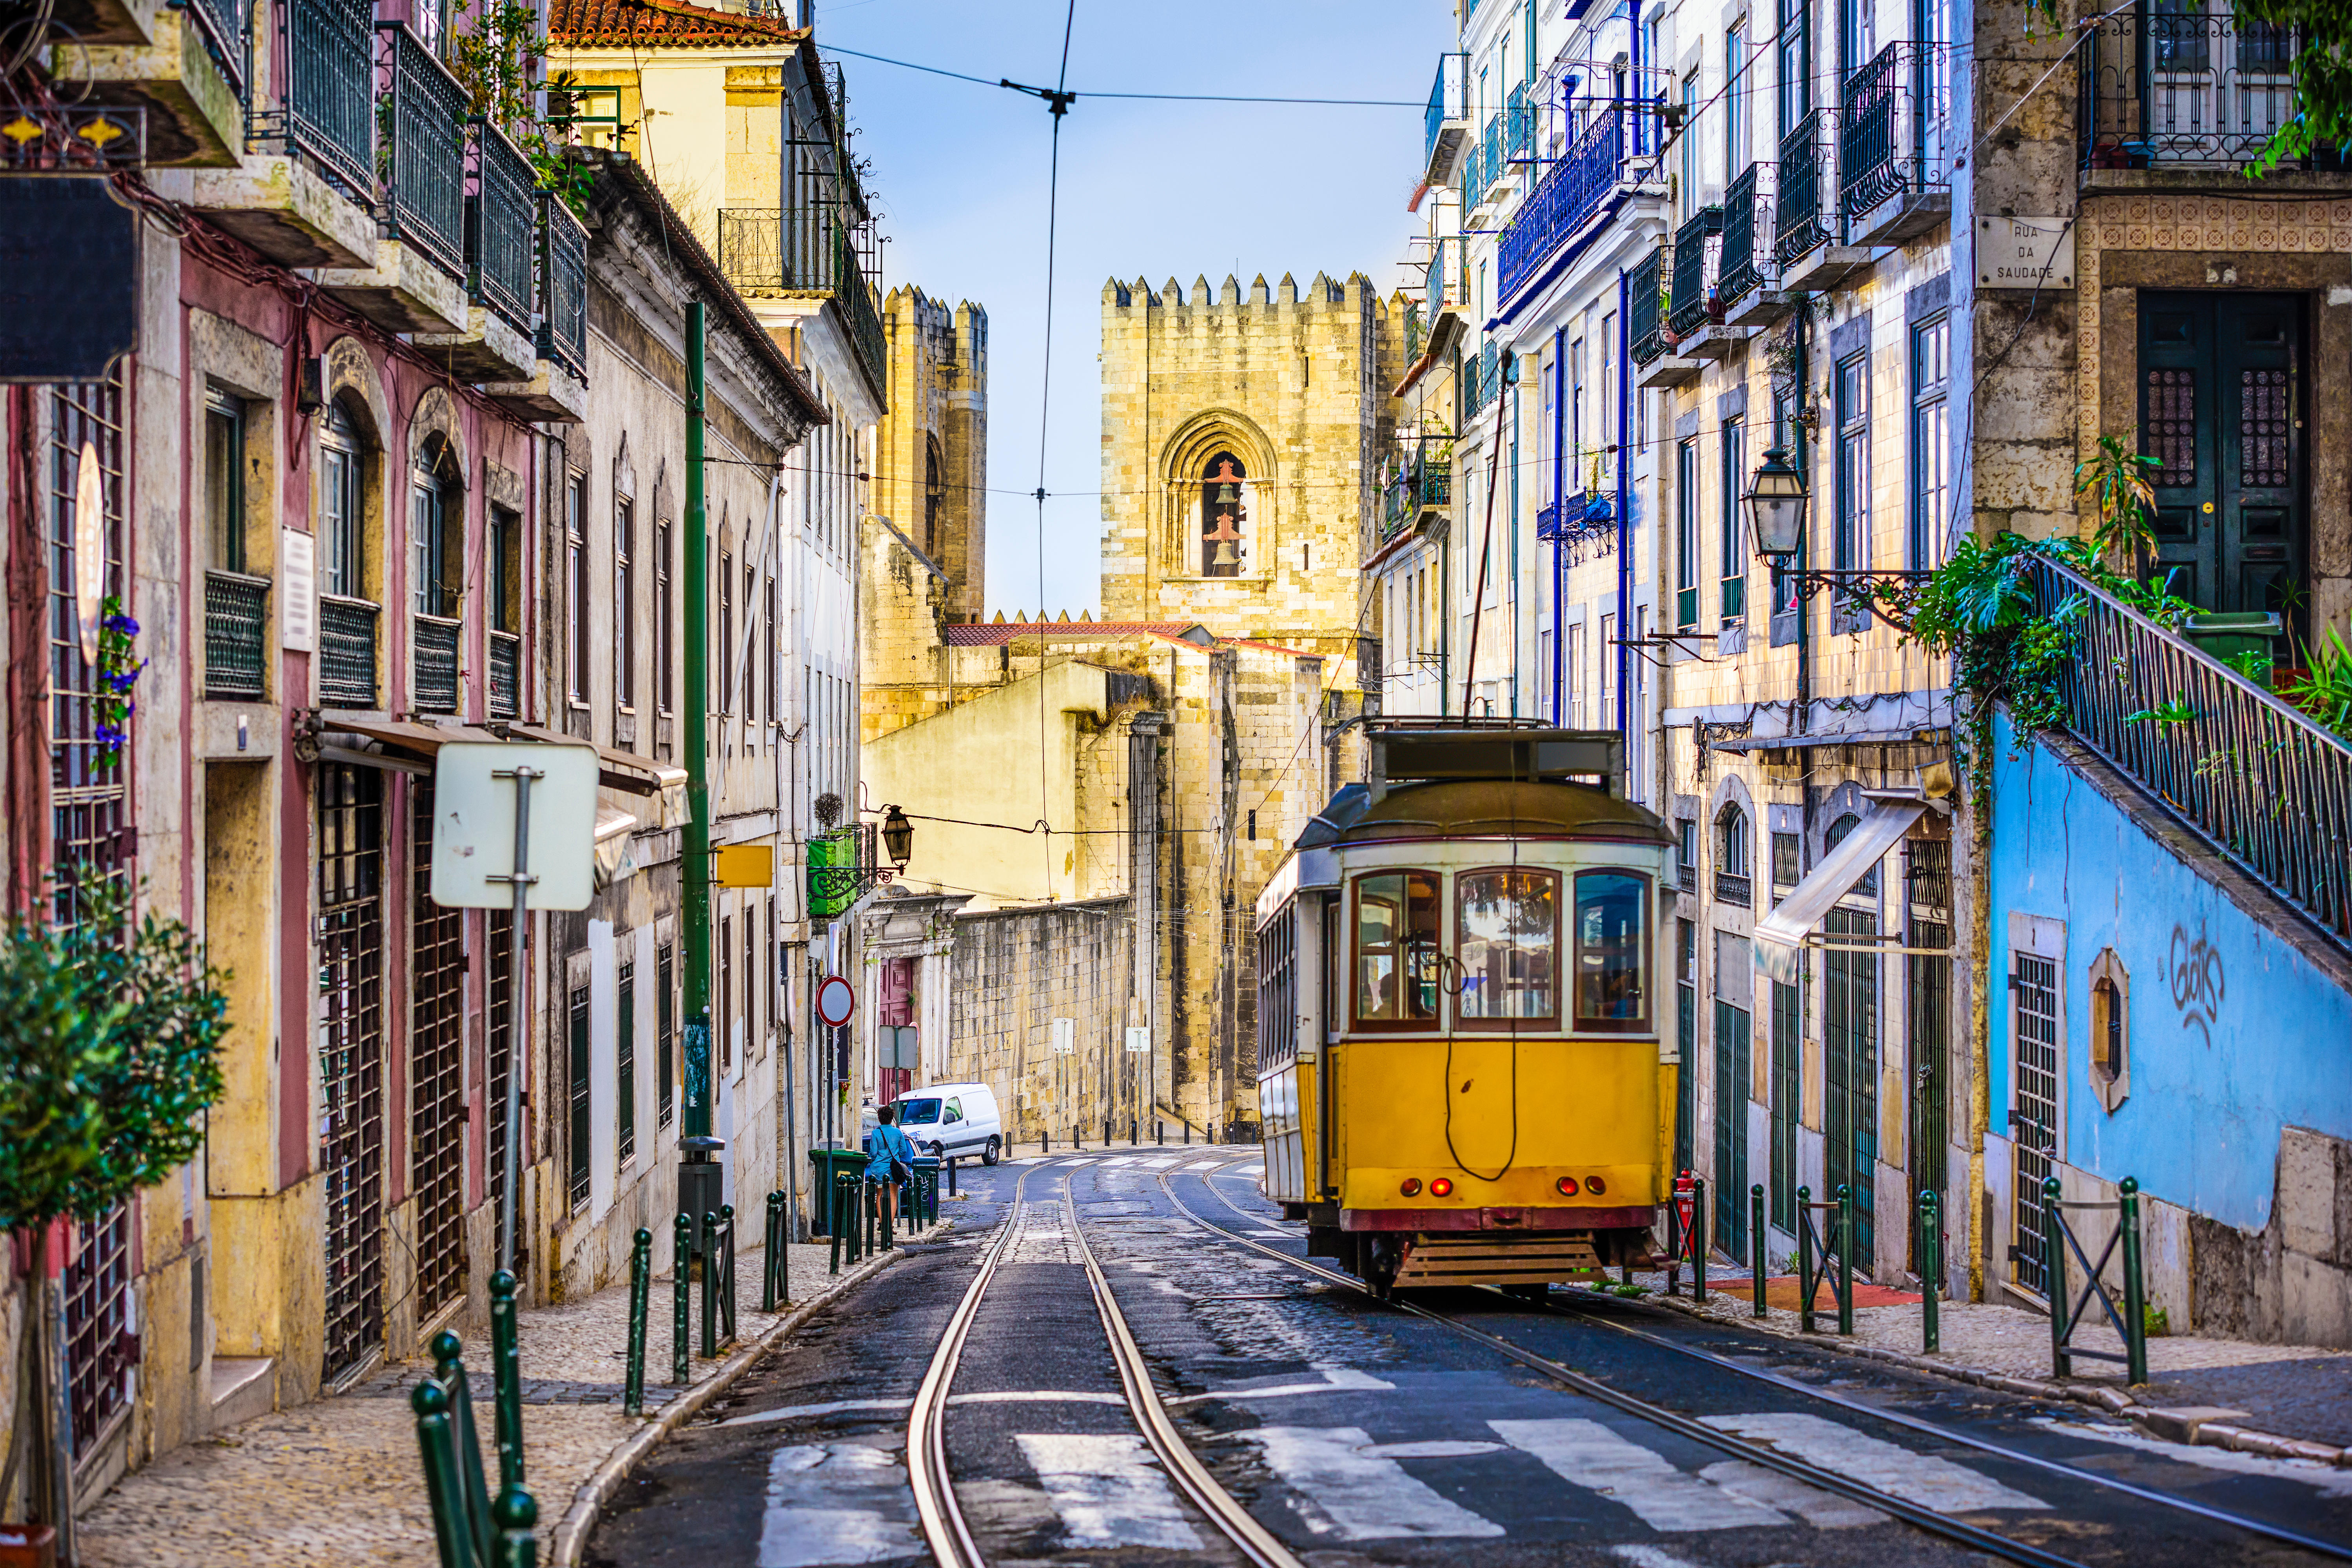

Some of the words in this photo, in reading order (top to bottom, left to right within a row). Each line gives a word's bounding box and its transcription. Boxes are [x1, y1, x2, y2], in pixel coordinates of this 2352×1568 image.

[2015, 227, 2037, 237] RUA
[2018, 247, 2033, 257] DA
[1998, 267, 2053, 278] SAUDADE
